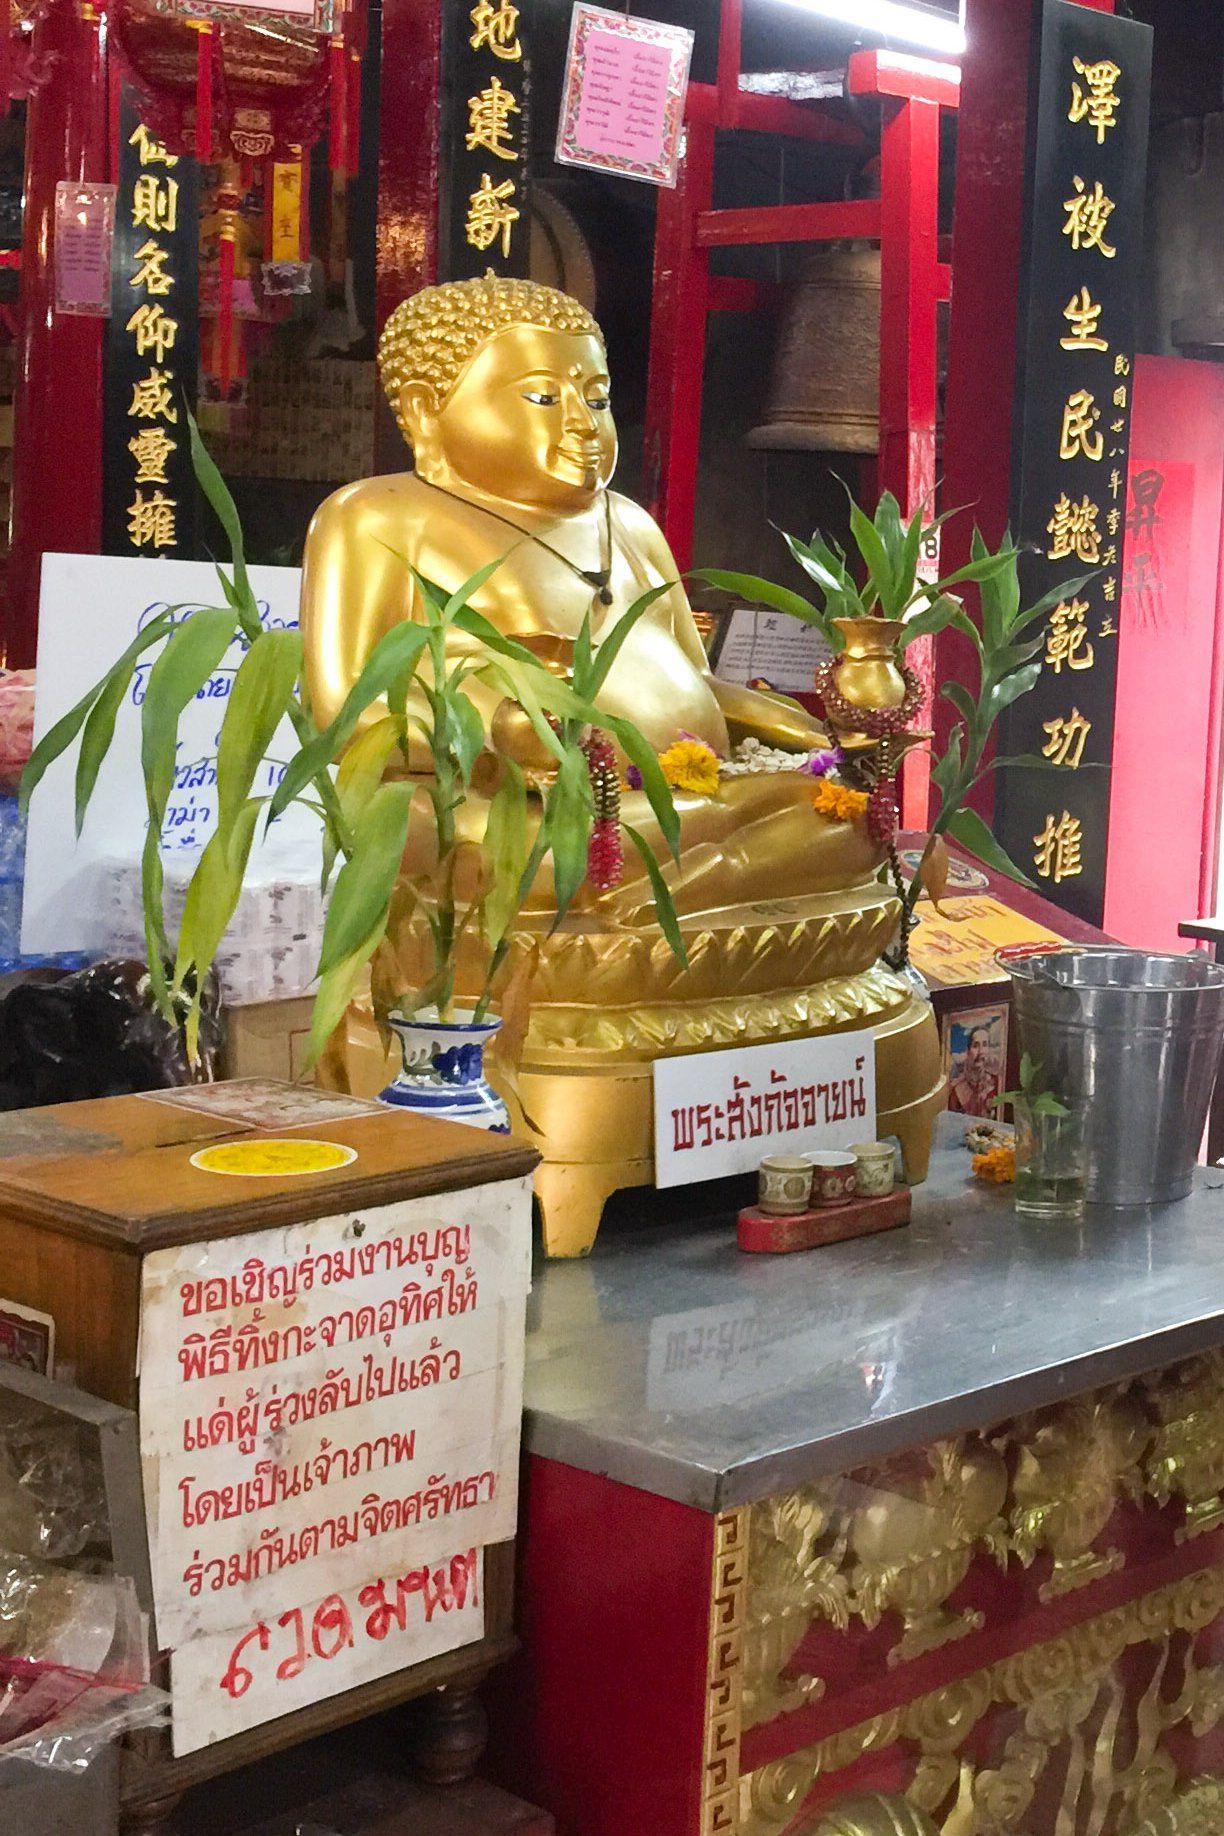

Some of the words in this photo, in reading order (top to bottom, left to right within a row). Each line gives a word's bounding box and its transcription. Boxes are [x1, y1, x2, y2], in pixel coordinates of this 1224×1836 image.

[126, 123, 179, 560] 仙則名仰威靈擁
[180, 1223, 472, 1317] ขอเชิญร่วมงานบุญ
[178, 1429, 416, 1528] โดยเป็นเจ้าภาพ
